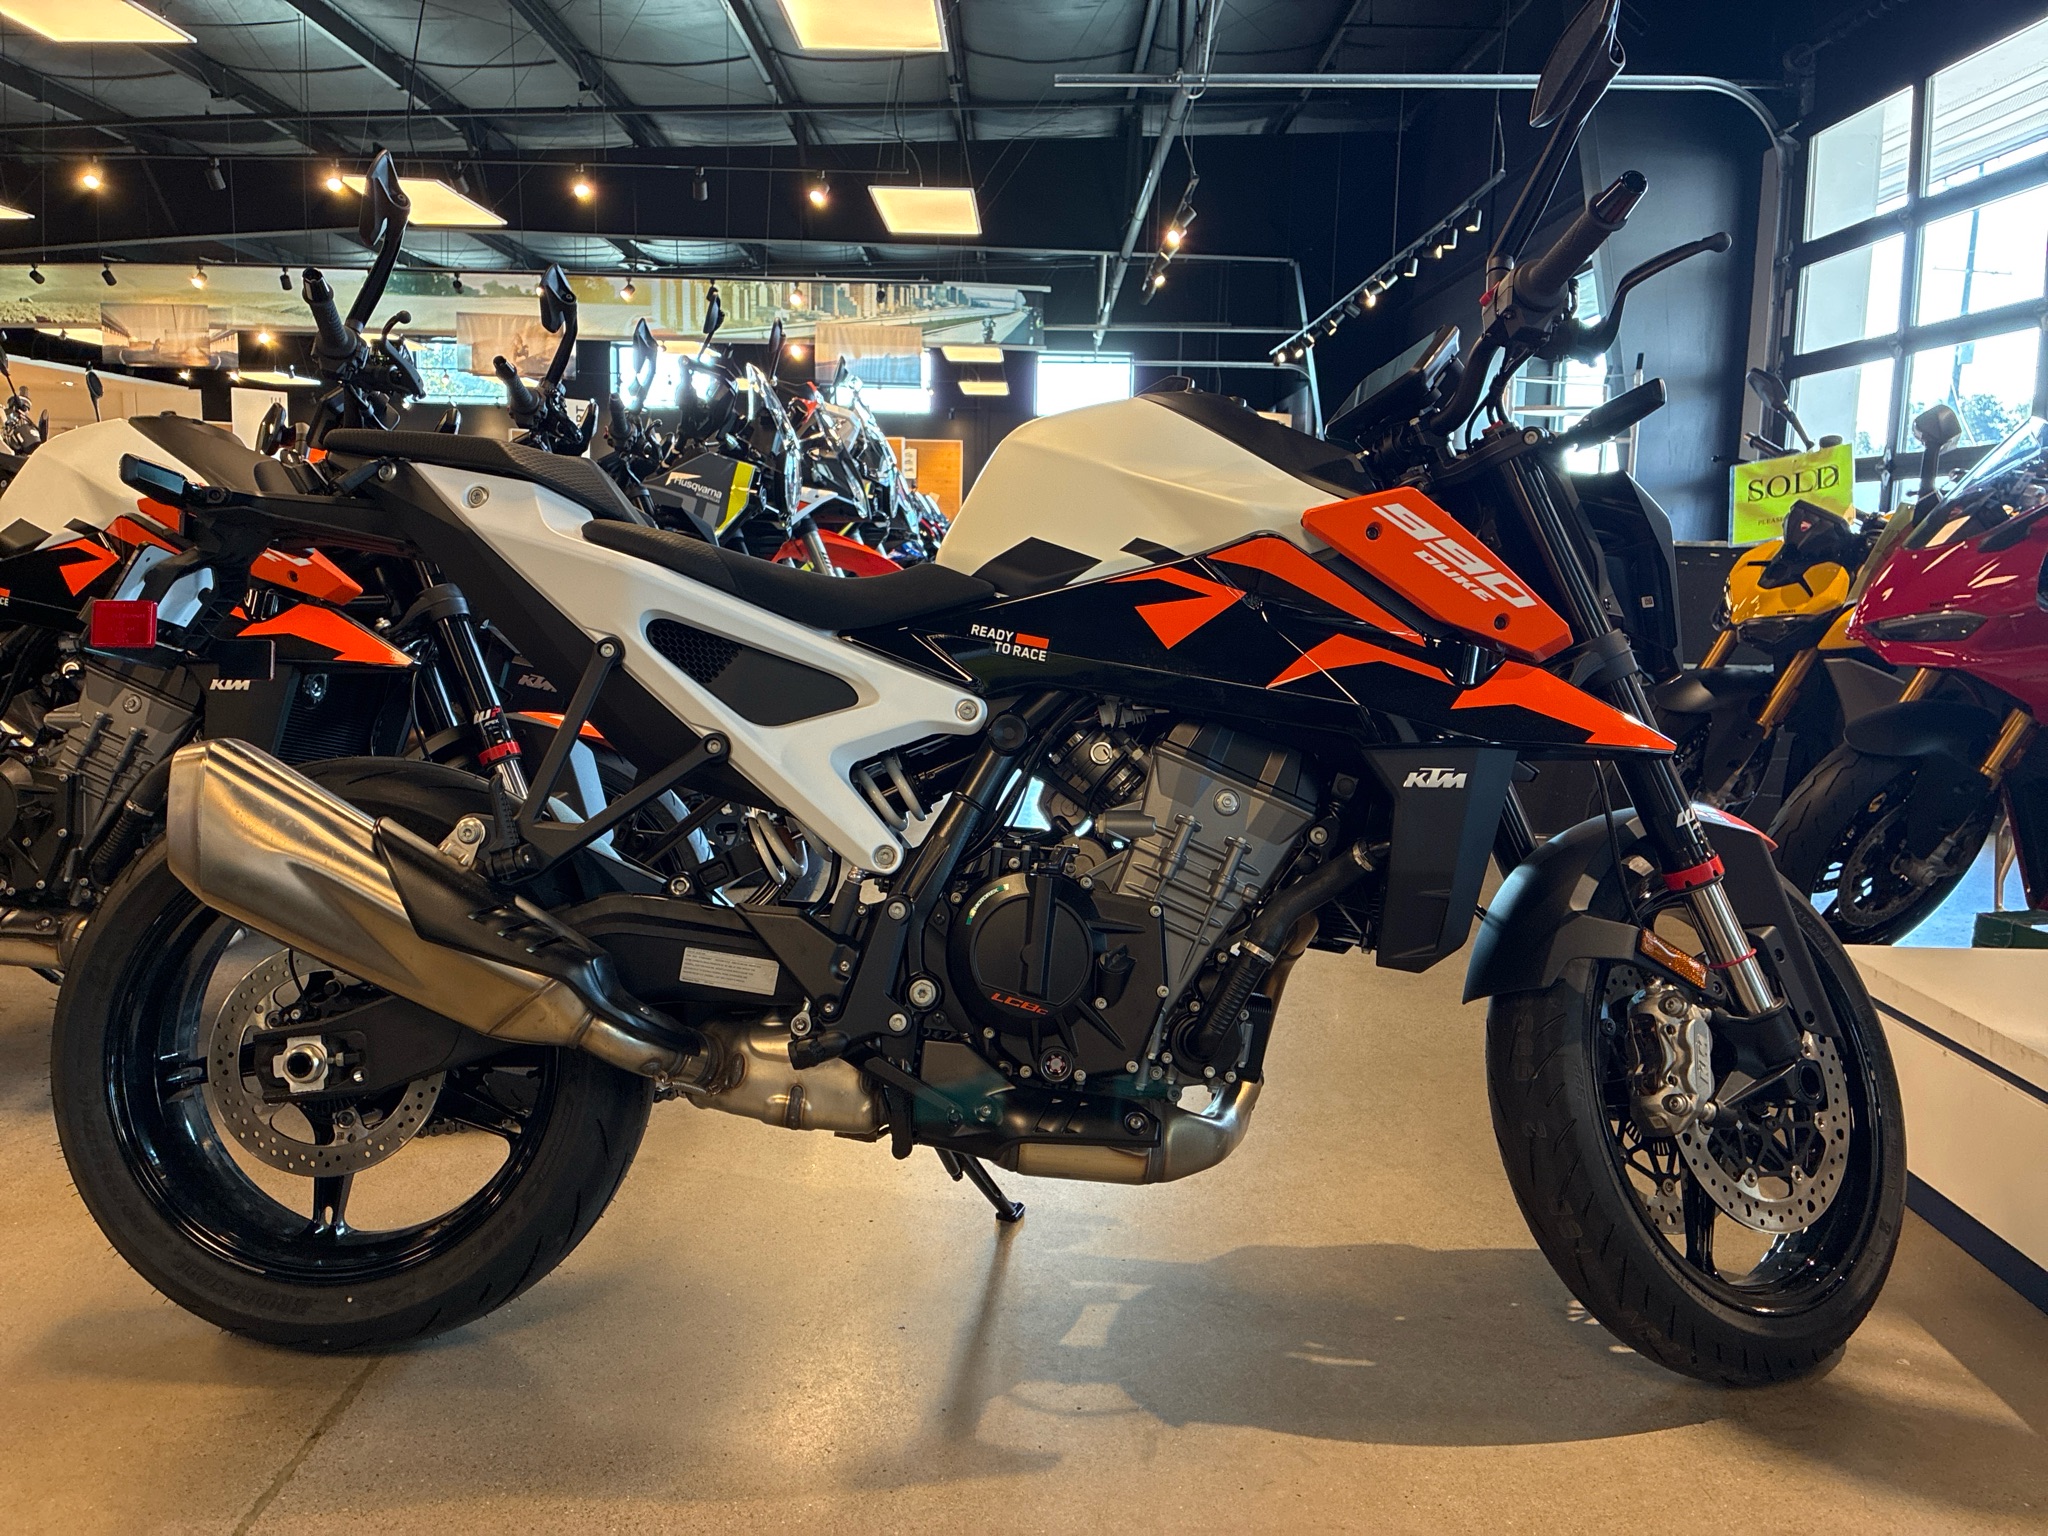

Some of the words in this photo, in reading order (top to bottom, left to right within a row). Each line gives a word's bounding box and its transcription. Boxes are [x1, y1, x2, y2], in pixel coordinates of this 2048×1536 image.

[673, 476, 722, 499] Husqvarna
[1748, 465, 1840, 502] SOLD
[1371, 503, 1537, 608] 990
[1413, 550, 1496, 602] DUKE
[970, 623, 1014, 642] READY
[995, 640, 1011, 654] TO
[1012, 644, 1047, 662] RACE
[209, 679, 250, 691] KTM
[518, 673, 558, 693] KTM
[1402, 767, 1468, 789] KTM
